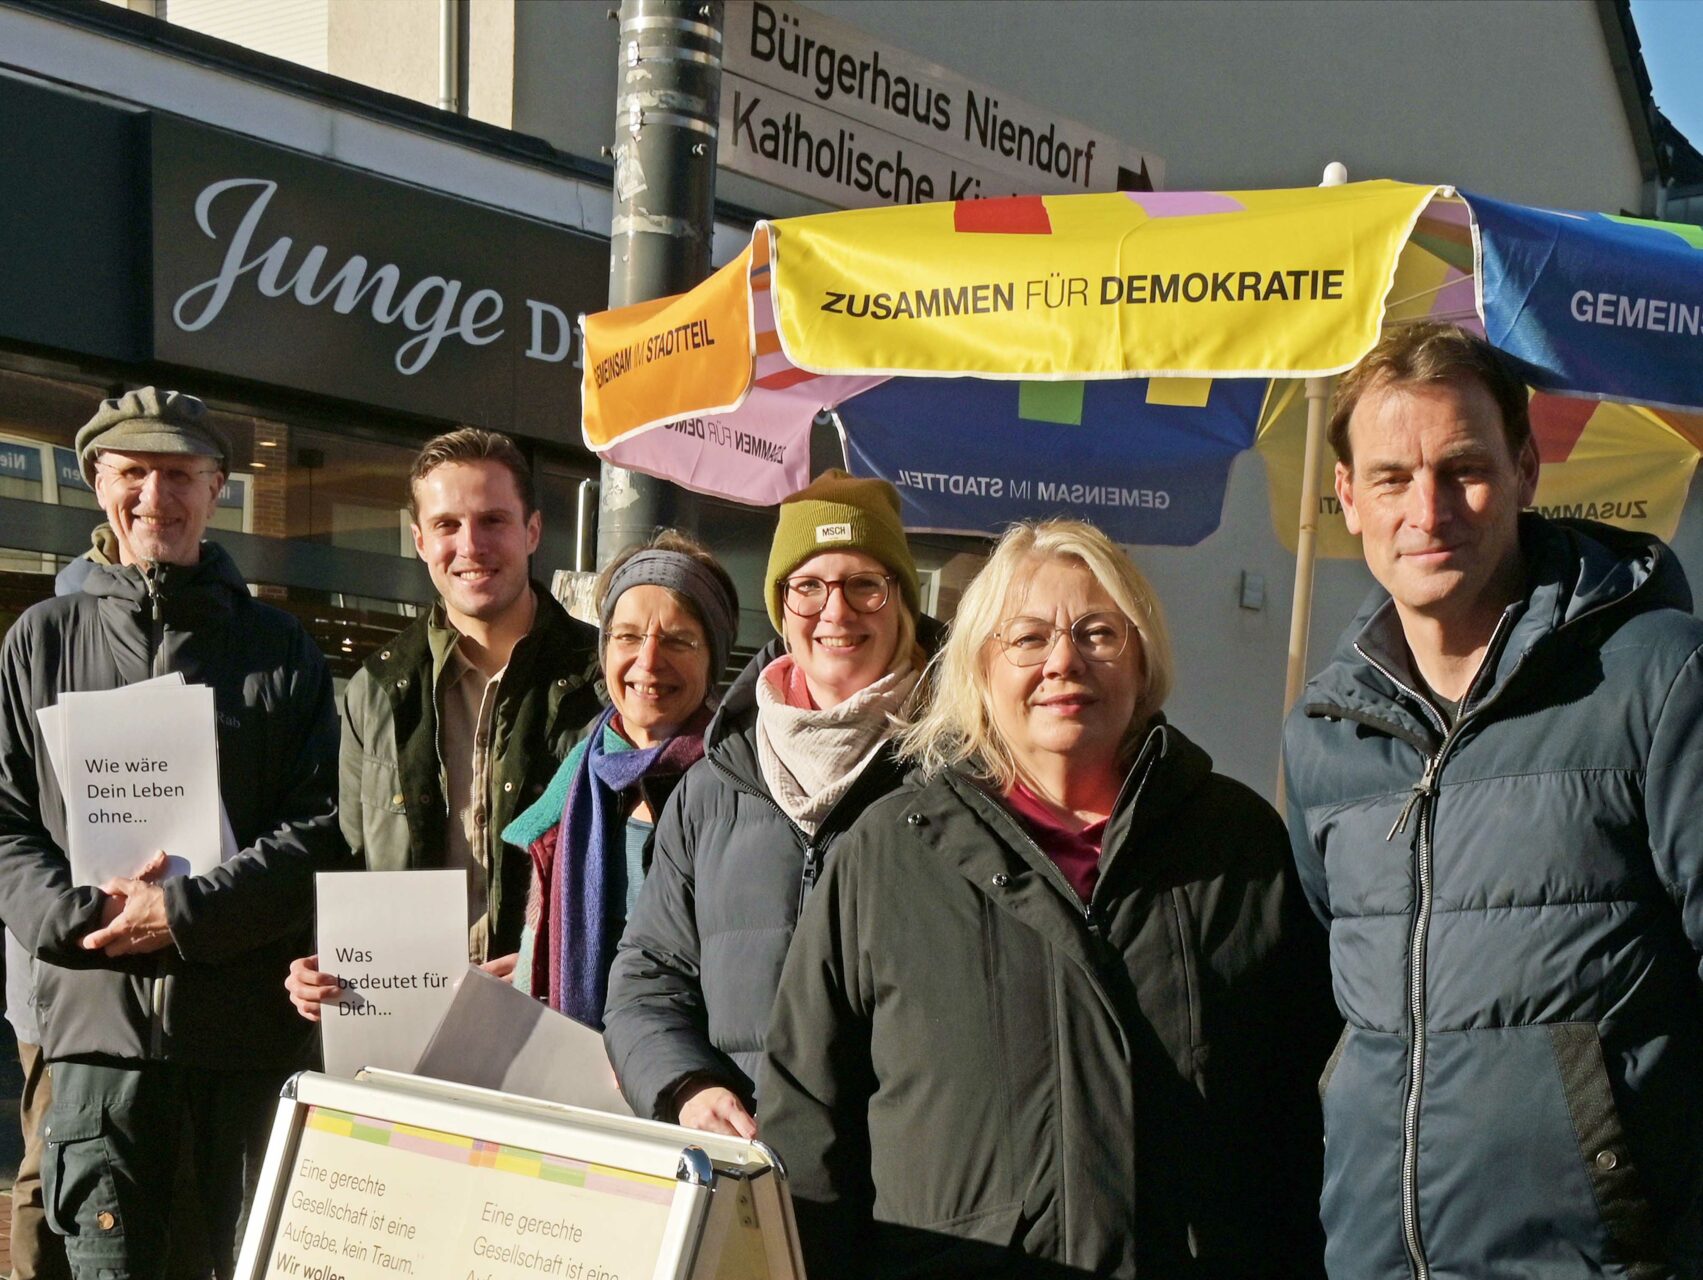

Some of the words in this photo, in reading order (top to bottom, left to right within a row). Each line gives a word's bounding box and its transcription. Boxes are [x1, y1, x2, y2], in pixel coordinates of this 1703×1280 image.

[751, 3, 950, 131] Bürgerhaus
[965, 90, 1095, 187] Niendorf
[732, 90, 934, 204] Katholische
[173, 178, 504, 375] Junge
[821, 282, 1013, 320] ZUSAMMEN
[1026, 273, 1088, 310] FÜR
[1100, 269, 1344, 304] DEMOKRATIE
[1570, 290, 1703, 336] GEMEIN
[646, 319, 715, 363] STADTTEIL
[822, 526, 846, 537] MSCH
[85, 759, 120, 774] Wie
[126, 758, 168, 774] wäre
[87, 783, 127, 799] Dein
[133, 782, 184, 798] Leben
[88, 808, 147, 824] ohne...
[337, 948, 373, 963] Was
[337, 973, 418, 990] bedeutet
[424, 972, 448, 989] für
[338, 1000, 392, 1016] Dich...
[300, 1159, 327, 1181] Eine
[329, 1171, 386, 1197] gerechte
[292, 1190, 368, 1226] Gesellschaft
[369, 1210, 384, 1231] ist
[387, 1217, 416, 1240] eine
[482, 1201, 514, 1227] Eine
[516, 1214, 583, 1243] gerechte
[276, 1252, 300, 1275] Wir
[342, 1237, 367, 1261] kein
[372, 1245, 414, 1275] Traum.
[473, 1235, 563, 1275] Gesellschaft
[566, 1258, 583, 1280] ist
